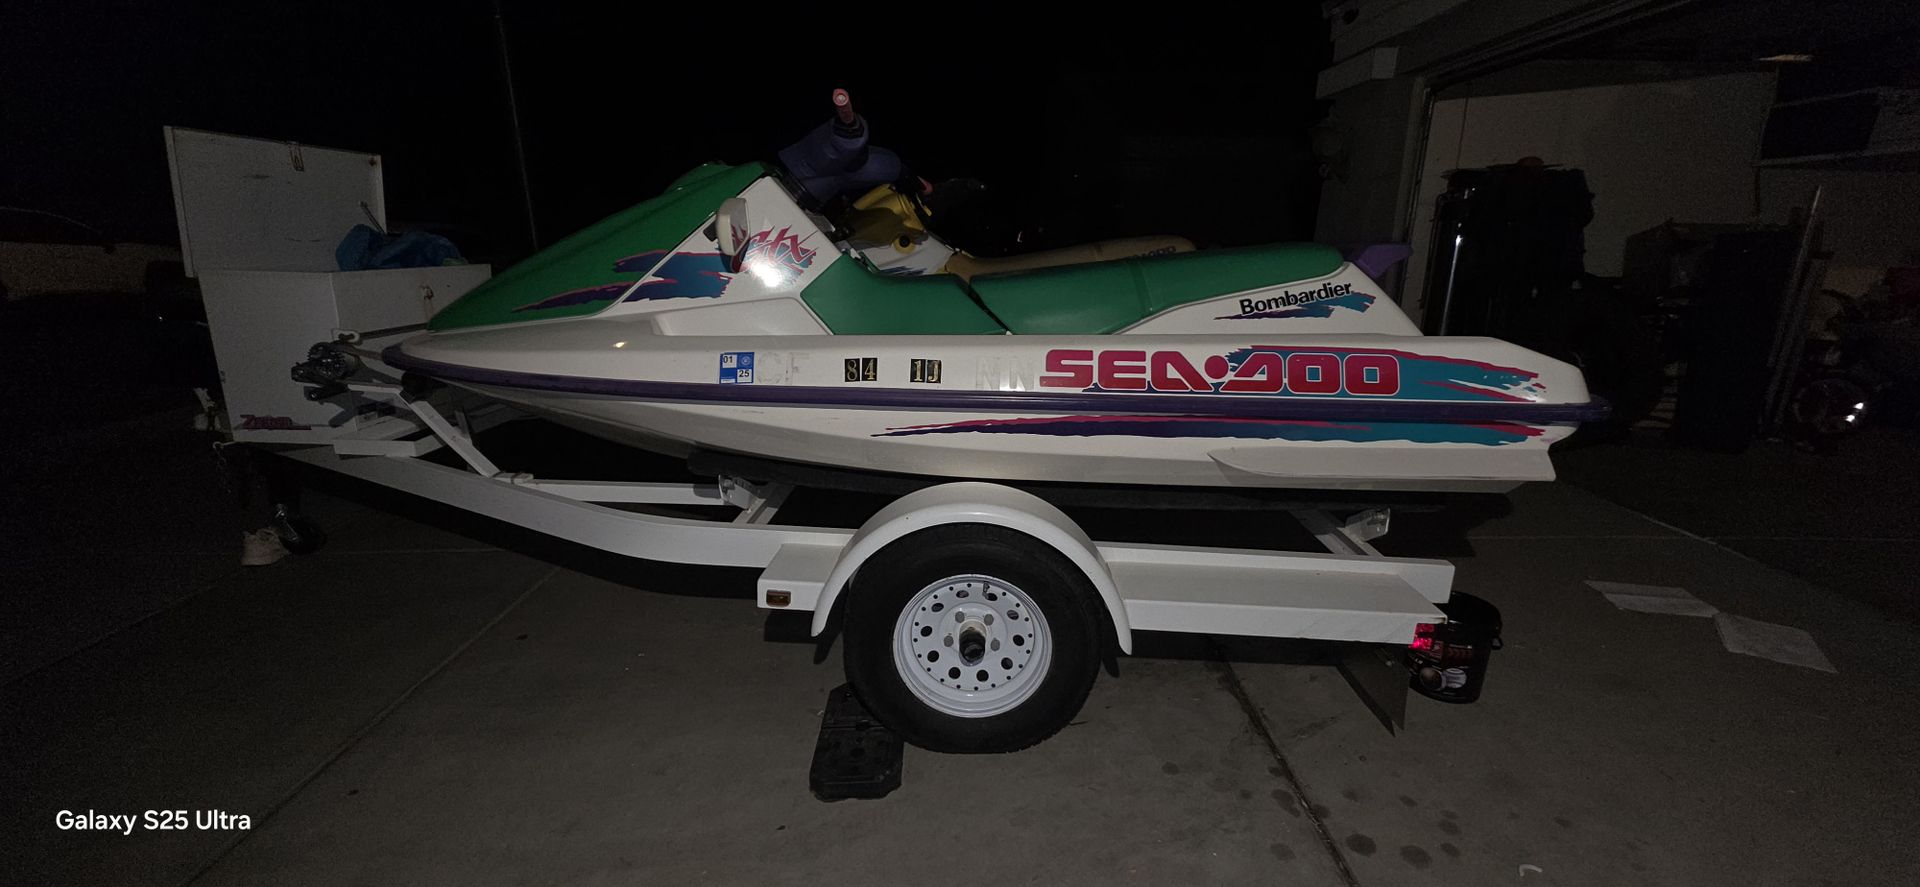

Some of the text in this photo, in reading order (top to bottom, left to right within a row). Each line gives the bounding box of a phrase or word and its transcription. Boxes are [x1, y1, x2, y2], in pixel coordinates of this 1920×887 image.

[1239, 282, 1352, 315] Bombardier
[723, 355, 733, 364] 01
[738, 369, 750, 378] 25
[846, 359, 876, 381] 84
